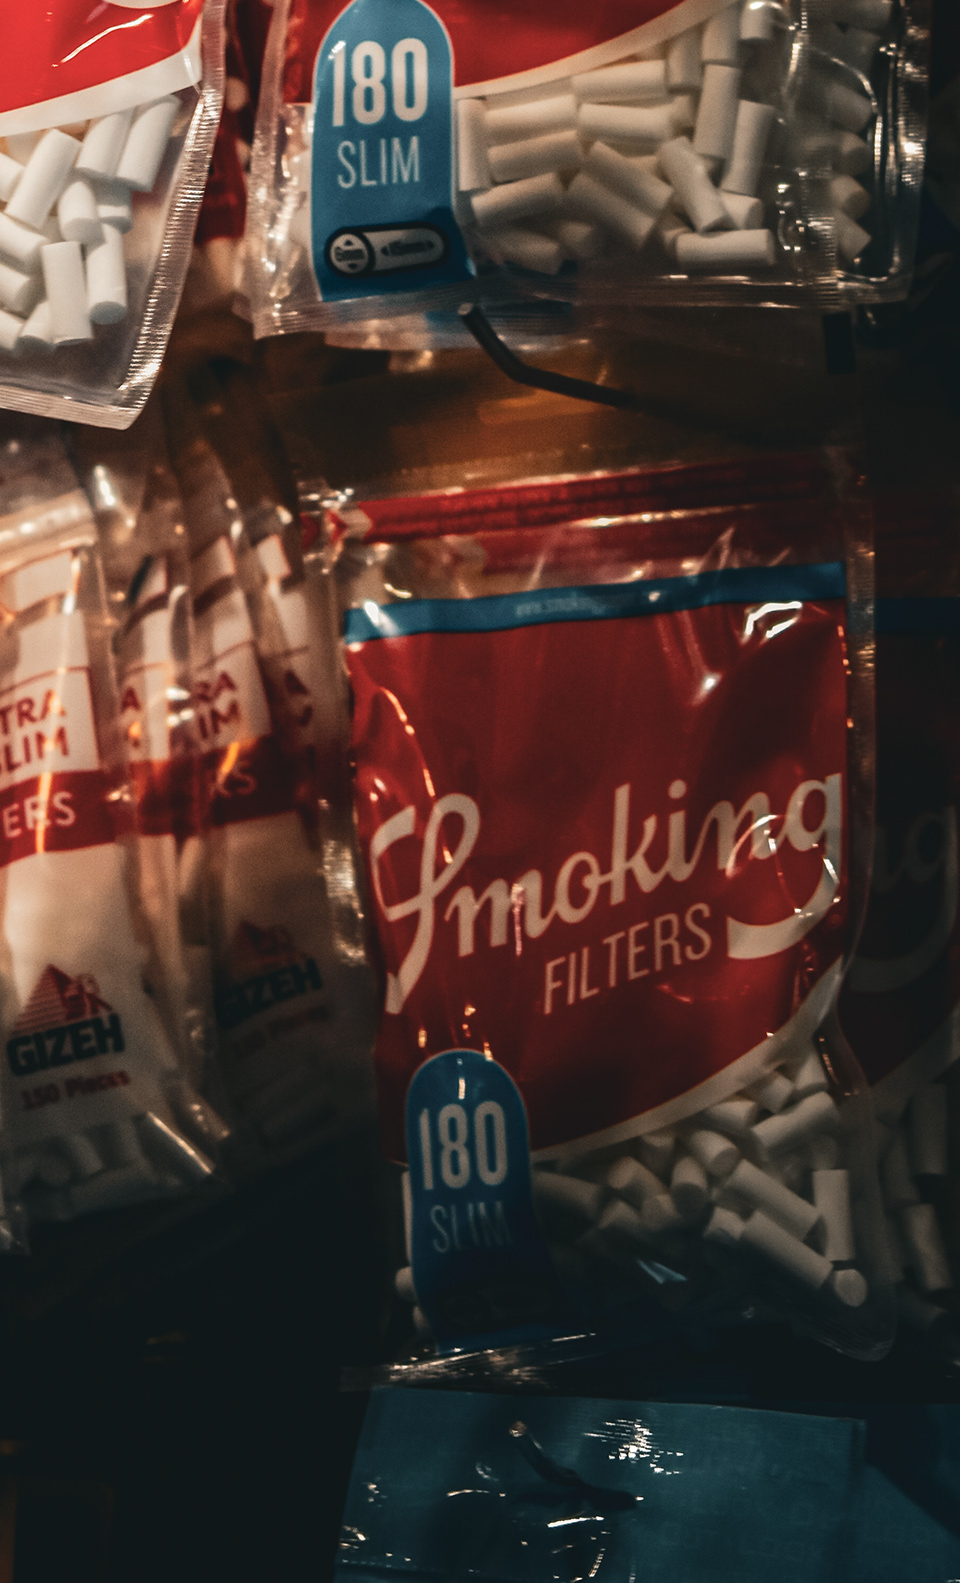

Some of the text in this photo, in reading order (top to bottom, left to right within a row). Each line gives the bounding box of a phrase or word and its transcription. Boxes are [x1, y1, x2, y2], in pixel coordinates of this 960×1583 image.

[328, 37, 429, 128] 180
[337, 135, 420, 190] SLIM
[369, 771, 843, 1016] Smoking
[543, 901, 713, 1015] FILTERS
[6, 1013, 126, 1077] GIZEH
[419, 1099, 509, 1191] 180
[430, 1200, 513, 1254] SLIM
